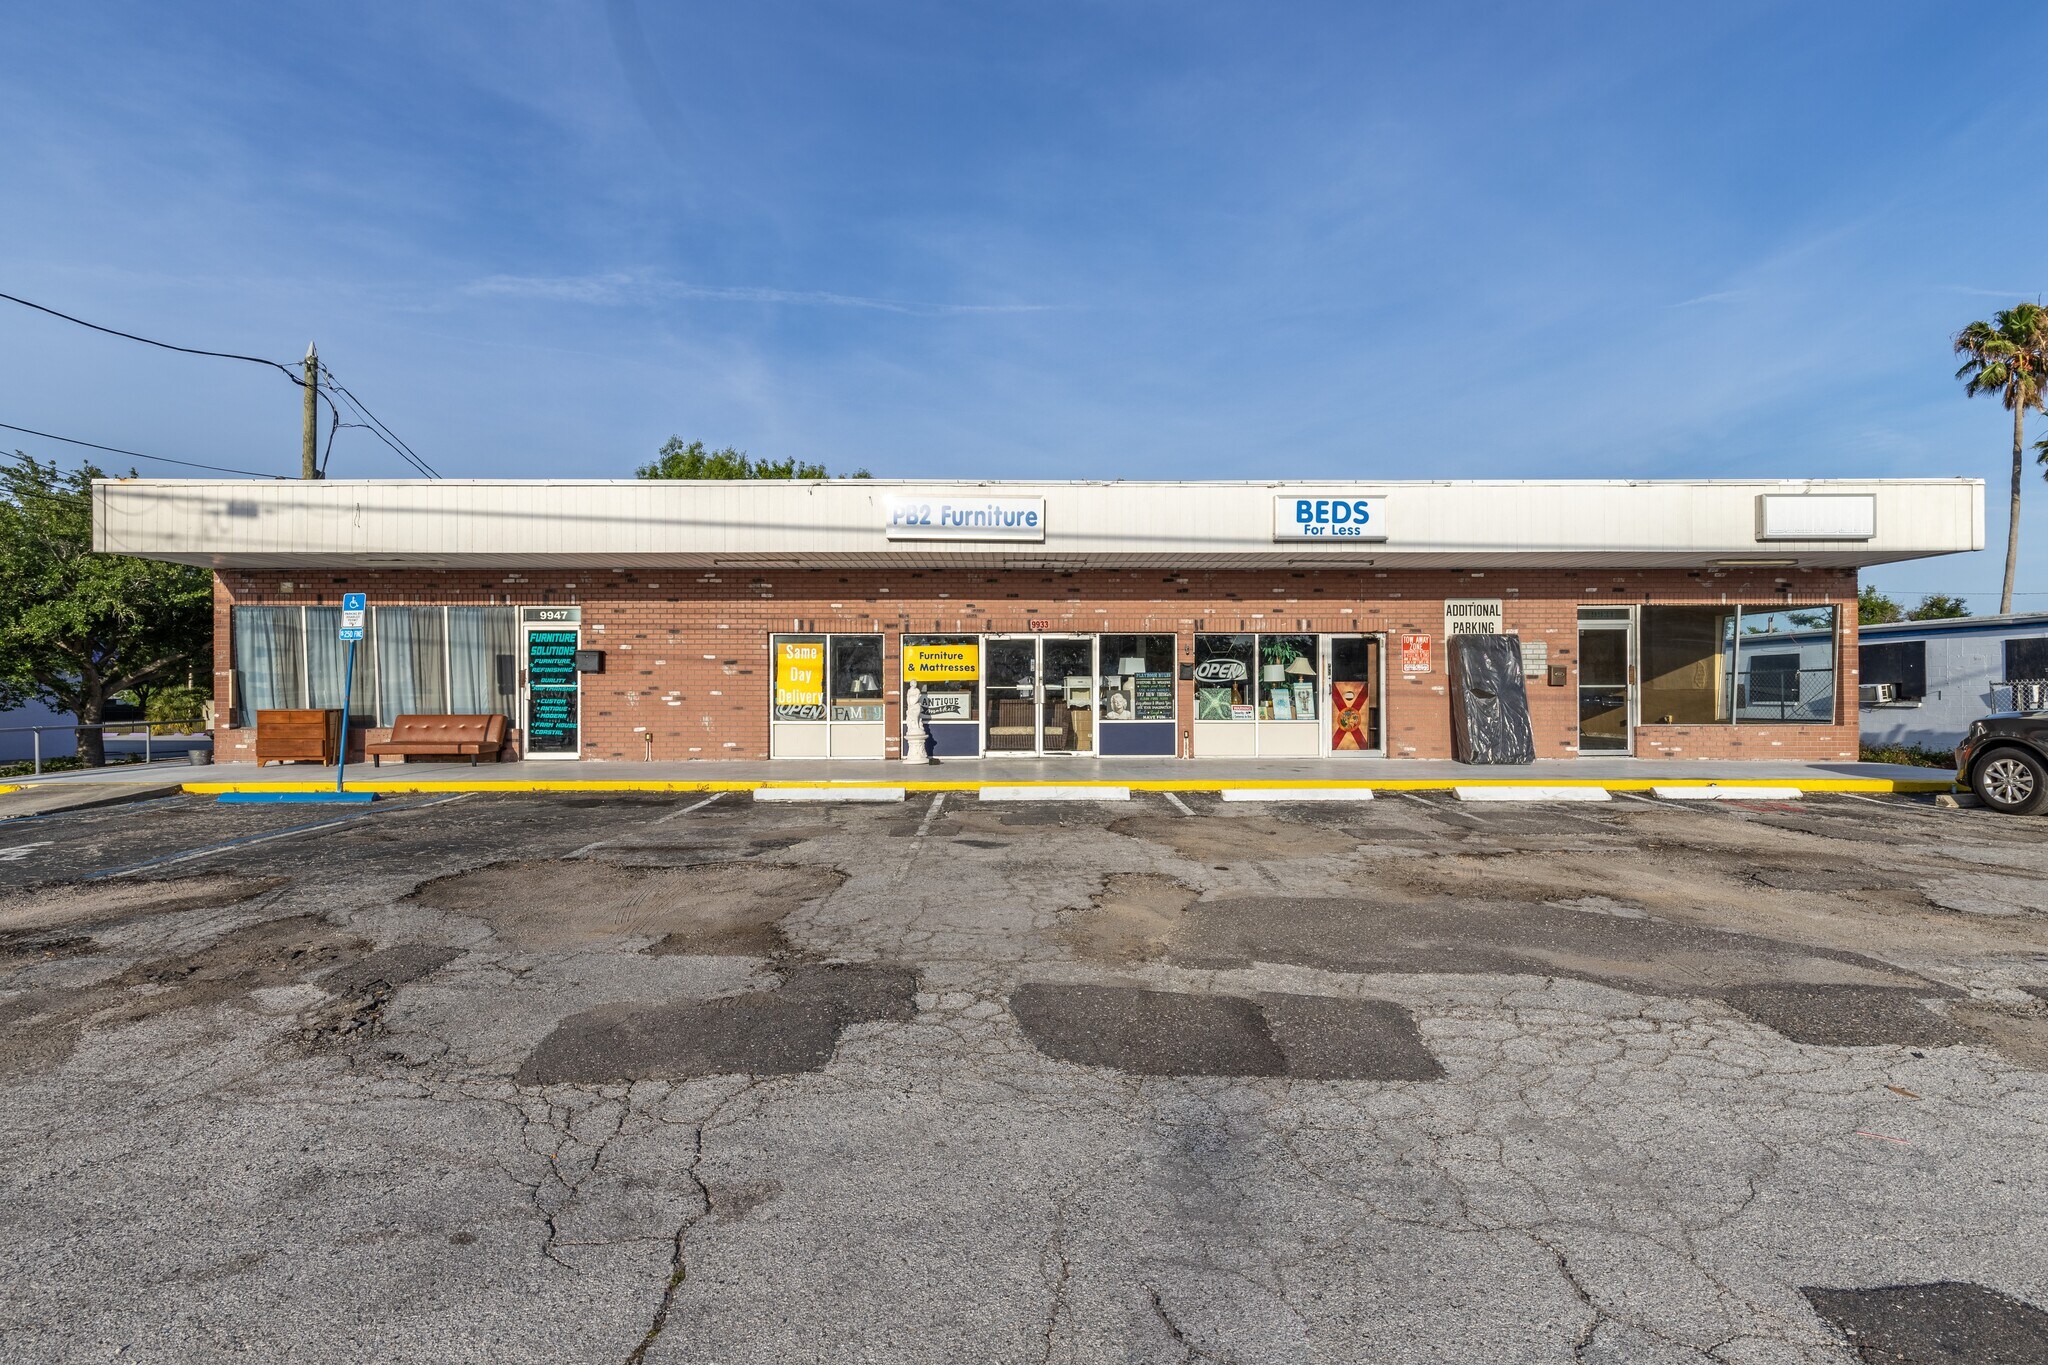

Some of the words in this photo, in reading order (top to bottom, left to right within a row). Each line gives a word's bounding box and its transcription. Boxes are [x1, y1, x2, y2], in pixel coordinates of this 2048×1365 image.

[893, 504, 931, 525] PB2
[941, 504, 1038, 527] Furniture
[1296, 500, 1369, 524] BEDS
[1304, 524, 1325, 535] For
[1332, 524, 1361, 535] Less
[540, 611, 568, 620] 9947
[1446, 604, 1501, 616] ADDITIONAL
[1031, 620, 1049, 629] 9933
[1453, 621, 1494, 634] PARKING
[529, 632, 576, 643] FURNITURE
[530, 646, 575, 656] SOLUTIONS
[786, 644, 817, 659] Same
[919, 651, 964, 660] Furniture
[908, 663, 915, 672] &
[920, 663, 976, 672] Mattresses
[1198, 662, 1239, 679] OPEN
[790, 667, 812, 684] Day
[778, 689, 824, 706] Delivery
[922, 697, 959, 707] ANTIQUE
[778, 704, 822, 720] OPEN
